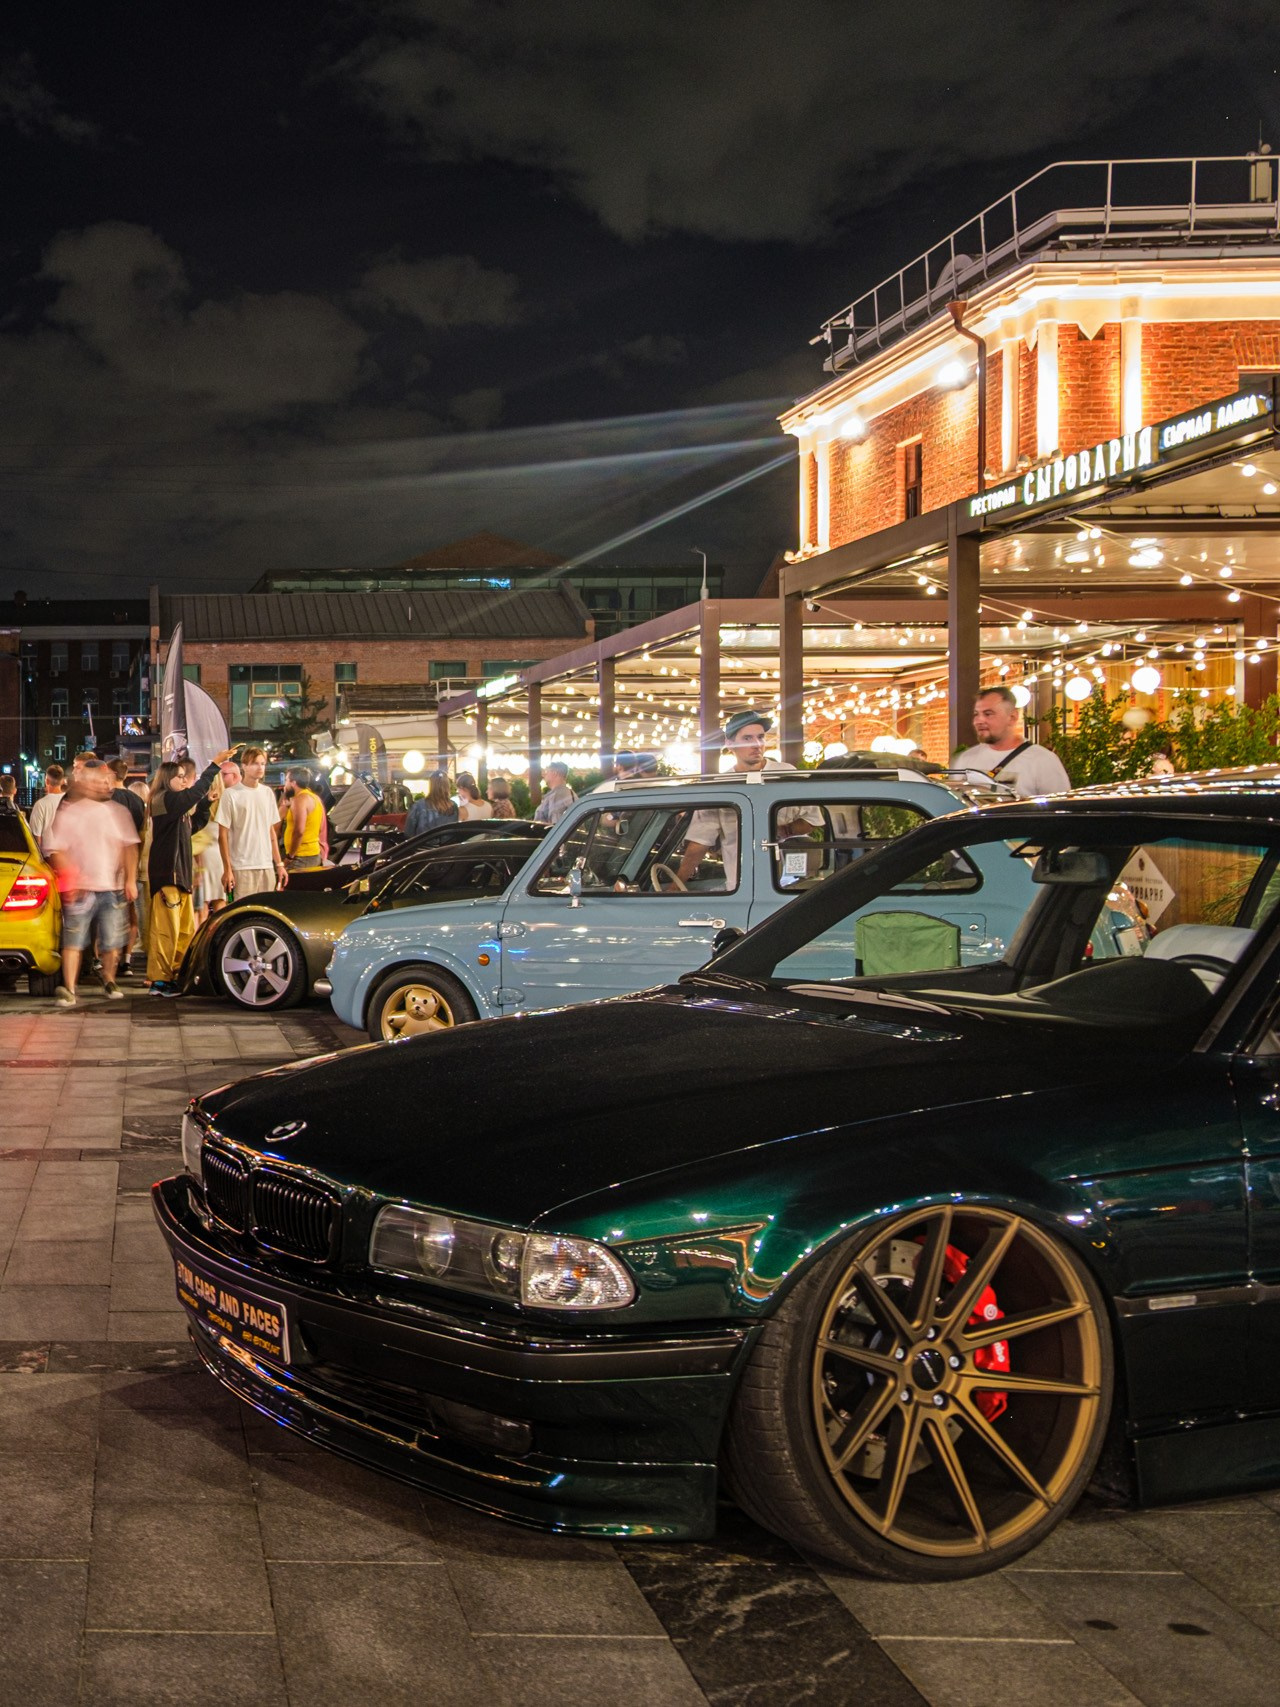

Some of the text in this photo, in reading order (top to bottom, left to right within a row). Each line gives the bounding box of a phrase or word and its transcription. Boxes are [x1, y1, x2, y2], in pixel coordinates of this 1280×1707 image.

[1023, 426, 1153, 506] СЫРОВАРНЯ
[1128, 885, 1163, 901] РОВАРНЯ
[242, 1302, 280, 1338] FACES
